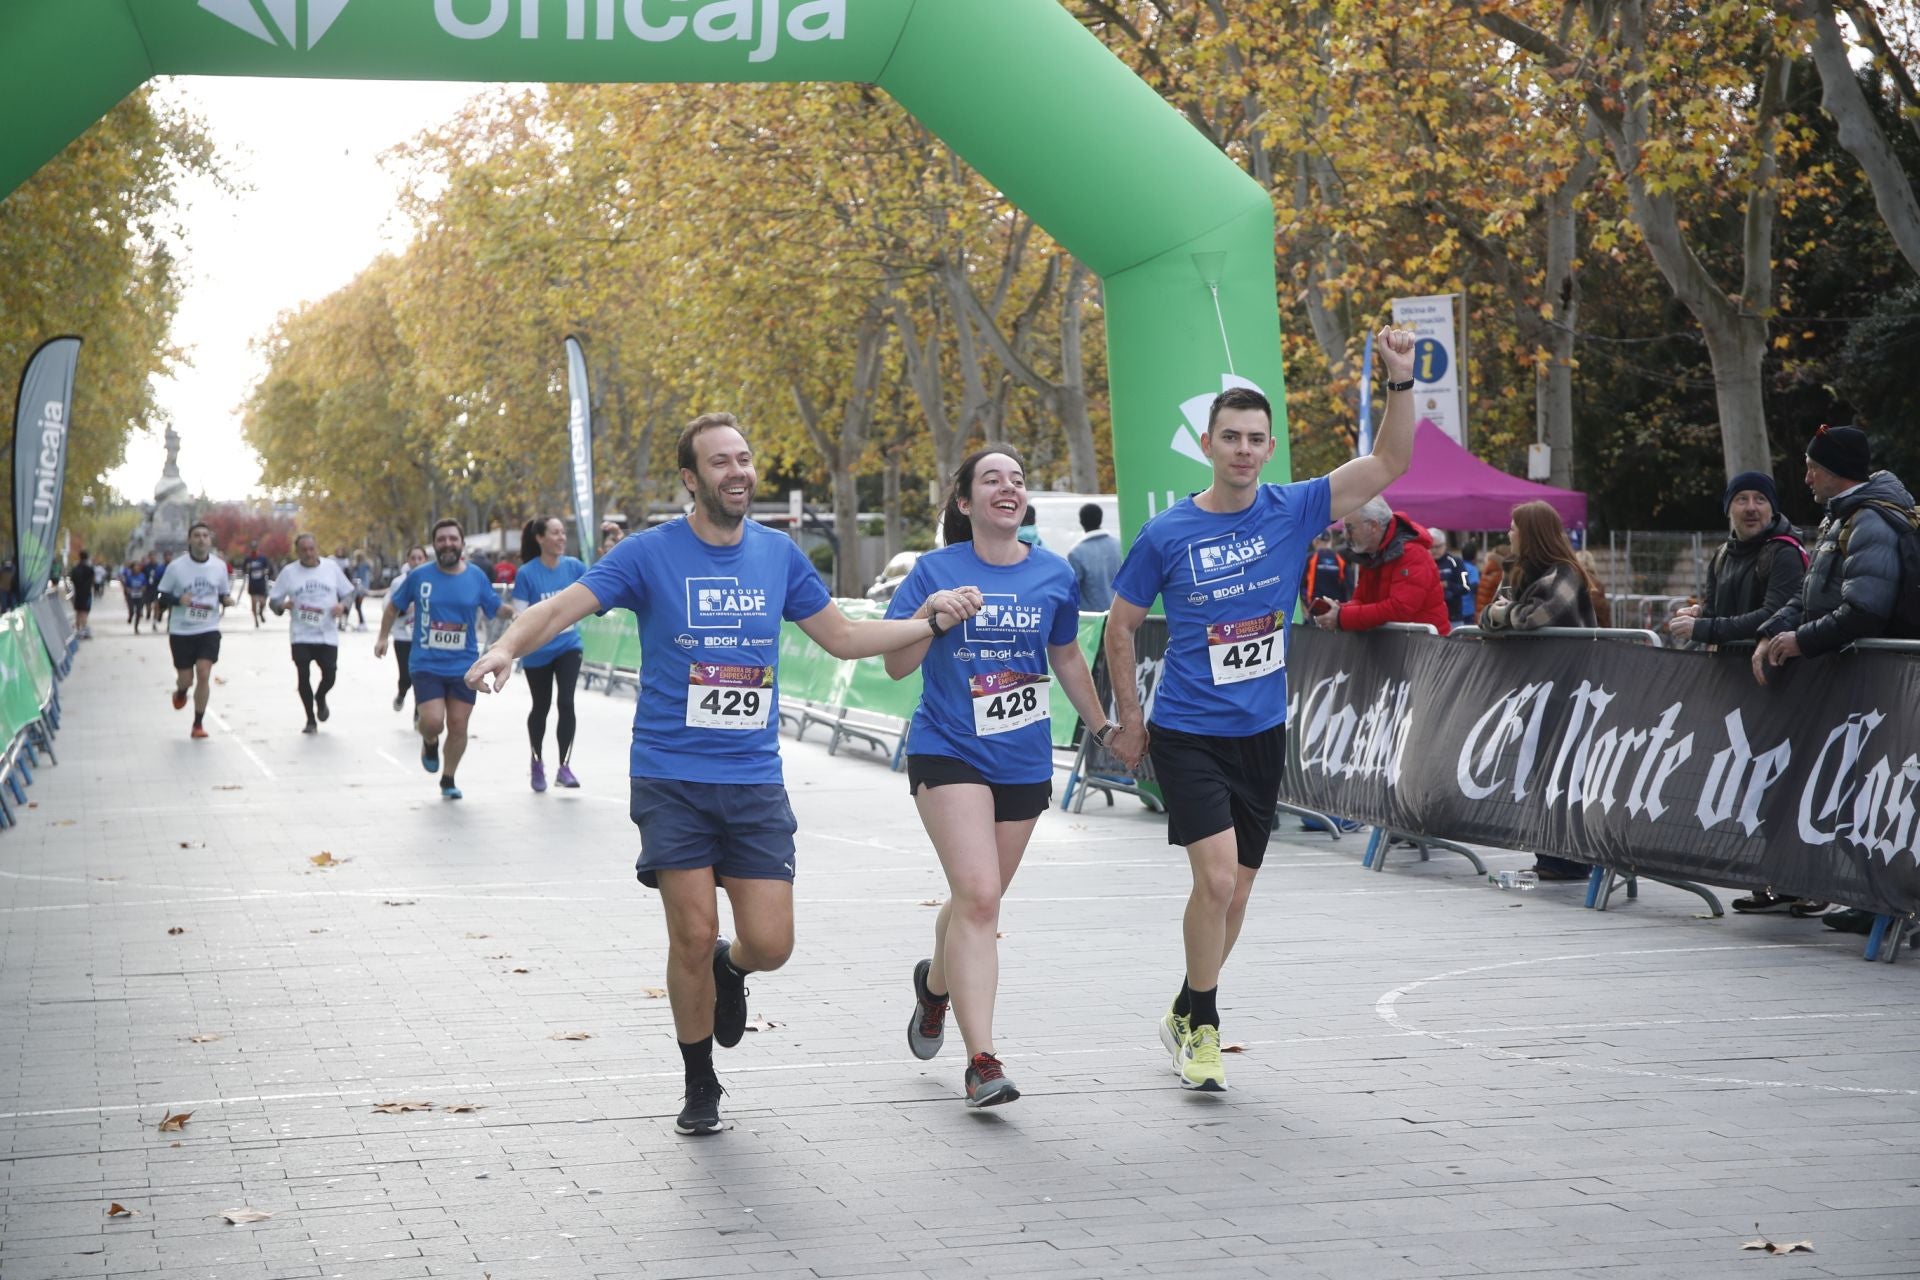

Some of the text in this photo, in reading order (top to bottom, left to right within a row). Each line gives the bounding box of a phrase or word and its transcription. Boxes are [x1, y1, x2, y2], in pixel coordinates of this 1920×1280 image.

[32, 400, 67, 525] Unicaja
[1221, 535, 1263, 551] GROUPE
[1226, 540, 1266, 565] ADF
[1222, 584, 1245, 597] DGH
[723, 595, 766, 611] ADF
[998, 605, 1042, 613] GROUPE
[420, 581, 432, 649] IVECO
[1000, 612, 1041, 628] ADF
[434, 632, 461, 644] 608
[713, 637, 737, 646] DGH
[989, 649, 1011, 659] DGH
[1222, 636, 1275, 669] 427
[719, 672, 752, 680] EMPRESAS
[720, 666, 744, 674] CARRERA
[986, 674, 997, 688] 9ª
[700, 690, 760, 717] 429
[986, 686, 1037, 720] 428
[1457, 679, 1920, 868] El Norte de Cas
